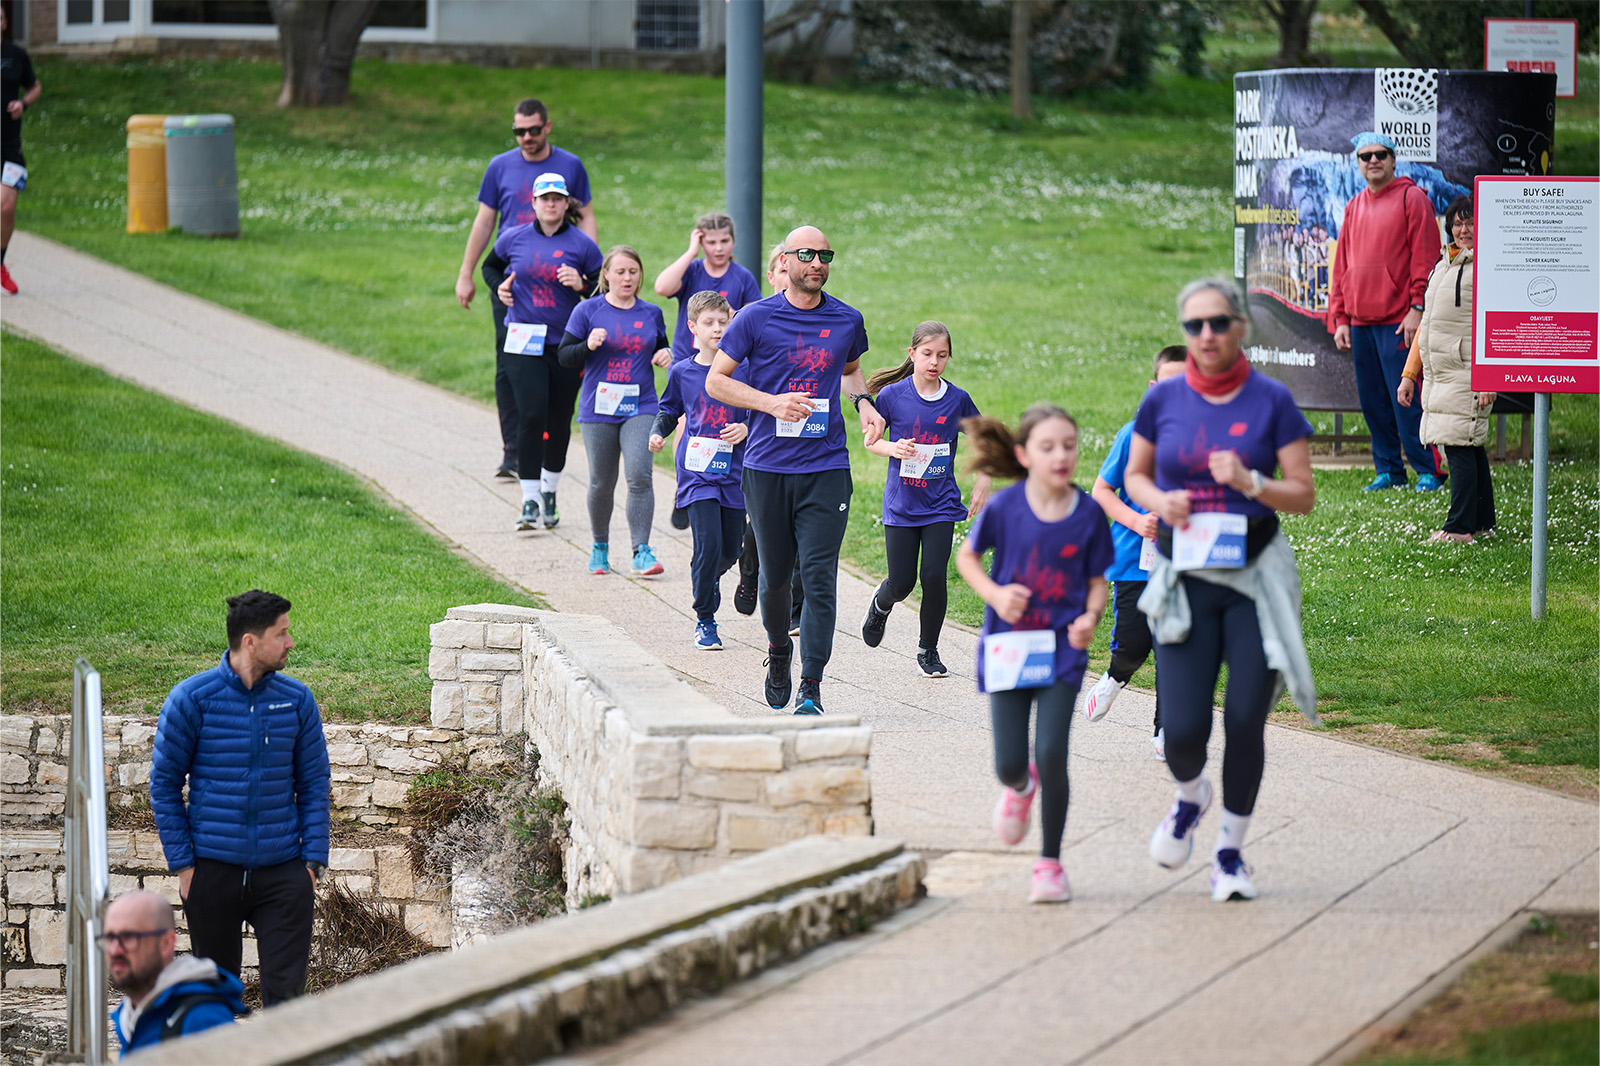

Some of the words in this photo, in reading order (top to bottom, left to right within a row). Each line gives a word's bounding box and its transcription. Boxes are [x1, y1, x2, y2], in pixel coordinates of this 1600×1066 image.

[1236, 90, 1261, 123] PARK
[1381, 122, 1431, 134] WORLD
[1389, 136, 1431, 148] MOUS
[1524, 188, 1540, 196] BUY
[1542, 188, 1564, 197] SAFE!
[1282, 204, 1300, 225] exist
[1279, 348, 1316, 367] weathers
[606, 372, 631, 382] 2026
[1504, 374, 1533, 382] PLAVA
[1538, 375, 1576, 385] LAGUNA
[789, 382, 818, 391] HALF
[903, 477, 928, 488] 2026
